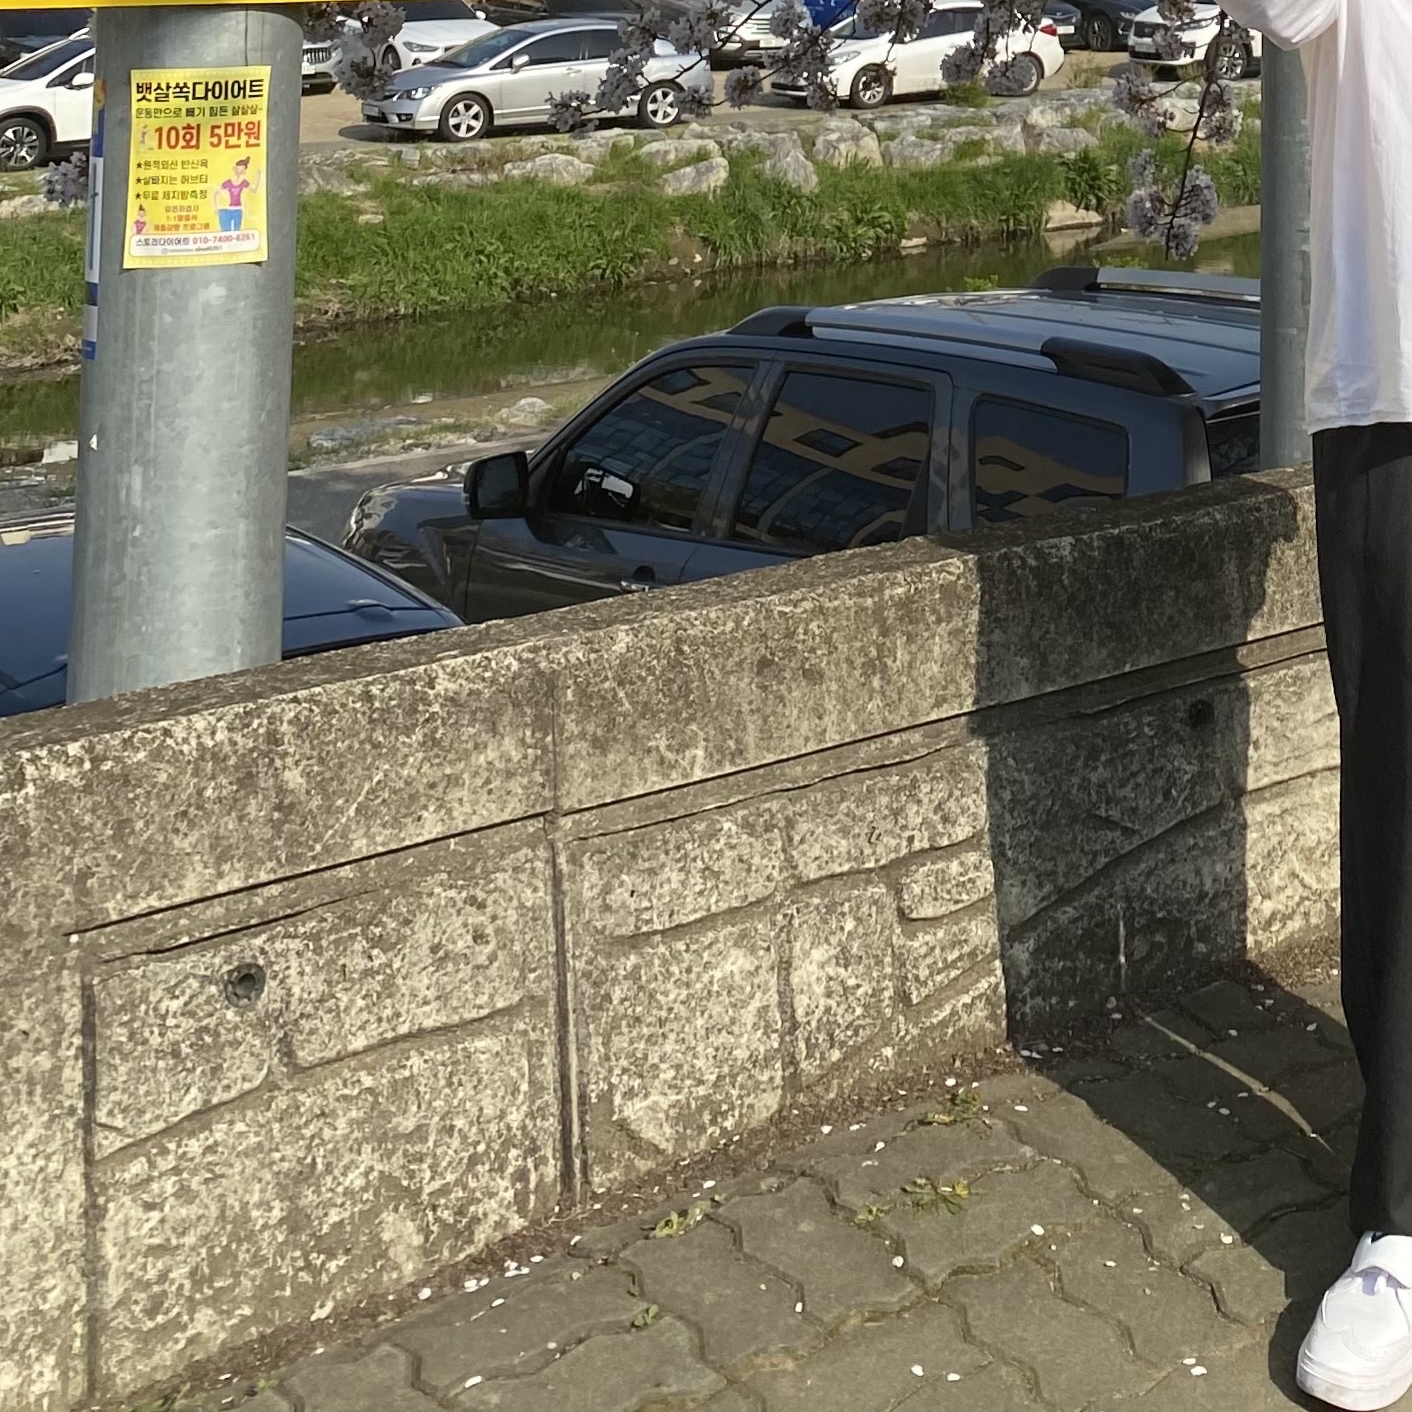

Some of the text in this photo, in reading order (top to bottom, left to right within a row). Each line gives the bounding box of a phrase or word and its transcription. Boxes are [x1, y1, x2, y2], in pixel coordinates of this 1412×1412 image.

[136, 79, 264, 103] 뱃살쏙다이어트
[154, 120, 261, 150] 10회 5만원
